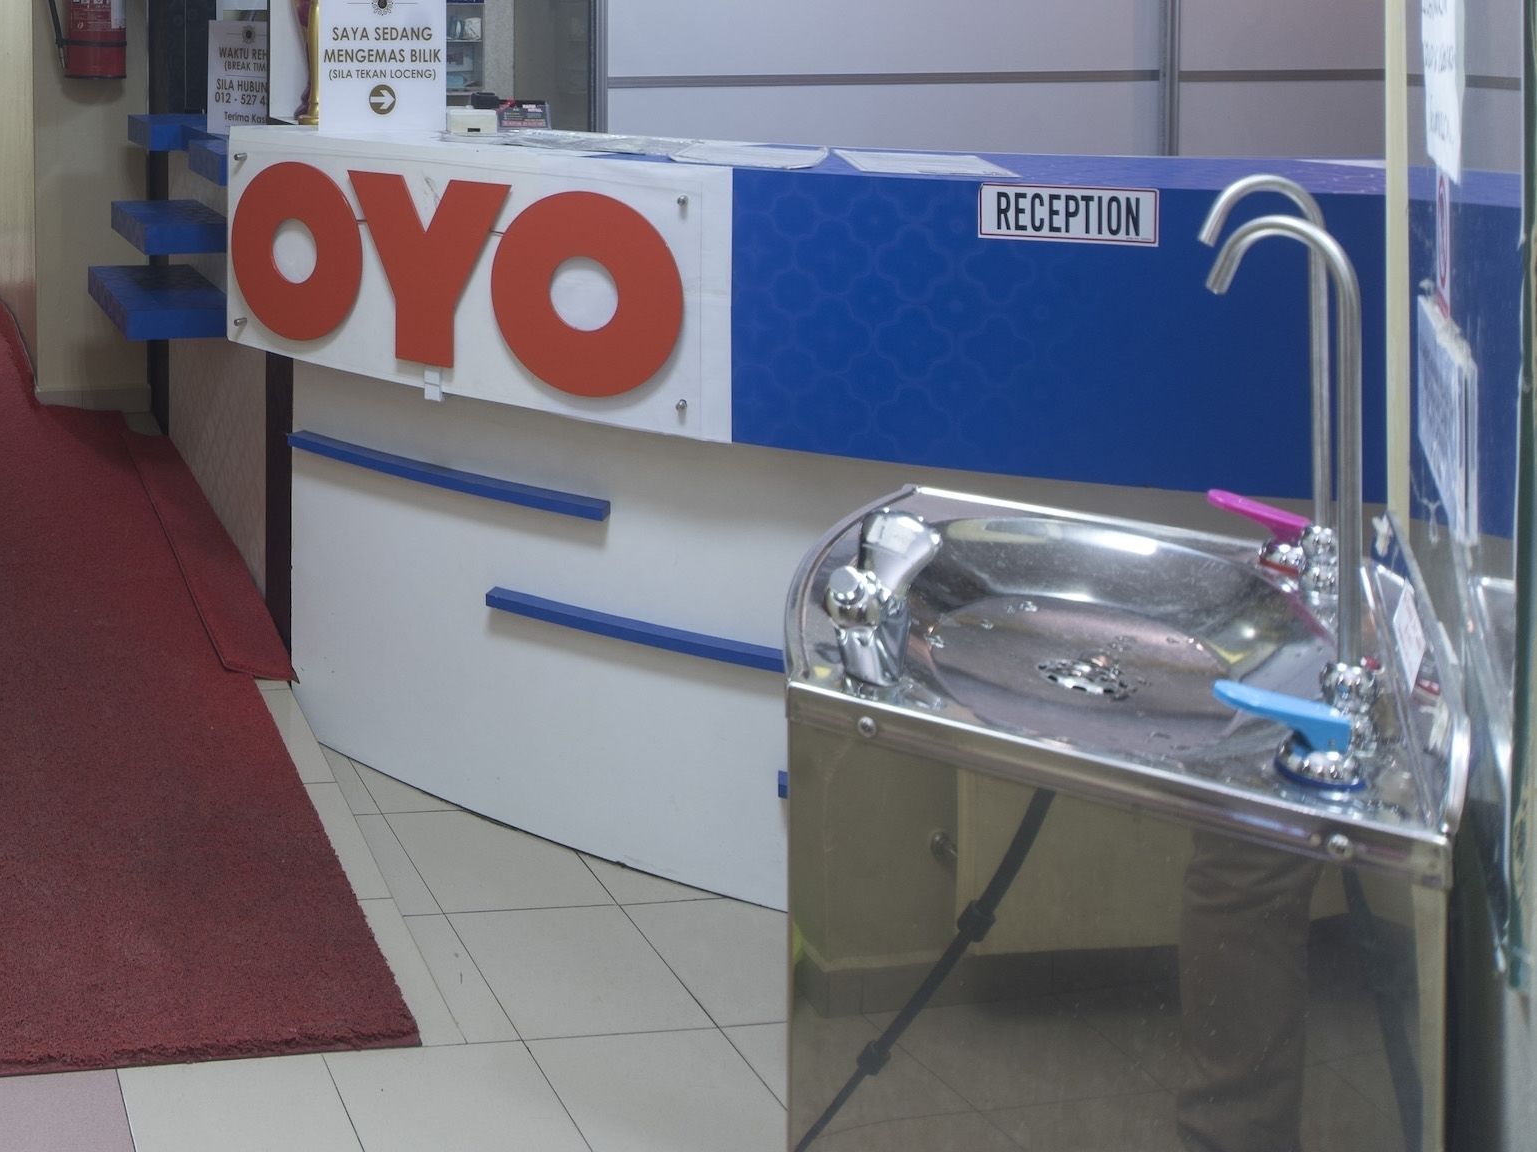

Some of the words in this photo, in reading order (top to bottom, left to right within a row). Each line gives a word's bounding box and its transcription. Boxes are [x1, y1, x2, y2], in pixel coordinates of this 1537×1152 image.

[332, 26, 370, 41] SAYA
[374, 26, 433, 41] SEDANG
[218, 47, 249, 59] WAKTU
[252, 48, 268, 61] REH
[323, 48, 406, 63] MENGEMAS
[410, 48, 442, 63] BILIK
[224, 60, 251, 72] (BREAK
[328, 68, 353, 81] (SILA
[355, 68, 387, 79] TEKAN
[389, 68, 437, 81] LOCENG)
[216, 78, 235, 91] SILA
[237, 79, 268, 93] HUBUN
[214, 91, 232, 104] 012
[240, 94, 258, 106] 527
[224, 111, 250, 122] Terima
[996, 191, 1141, 237] RECEPTION
[231, 160, 685, 398] OYO
